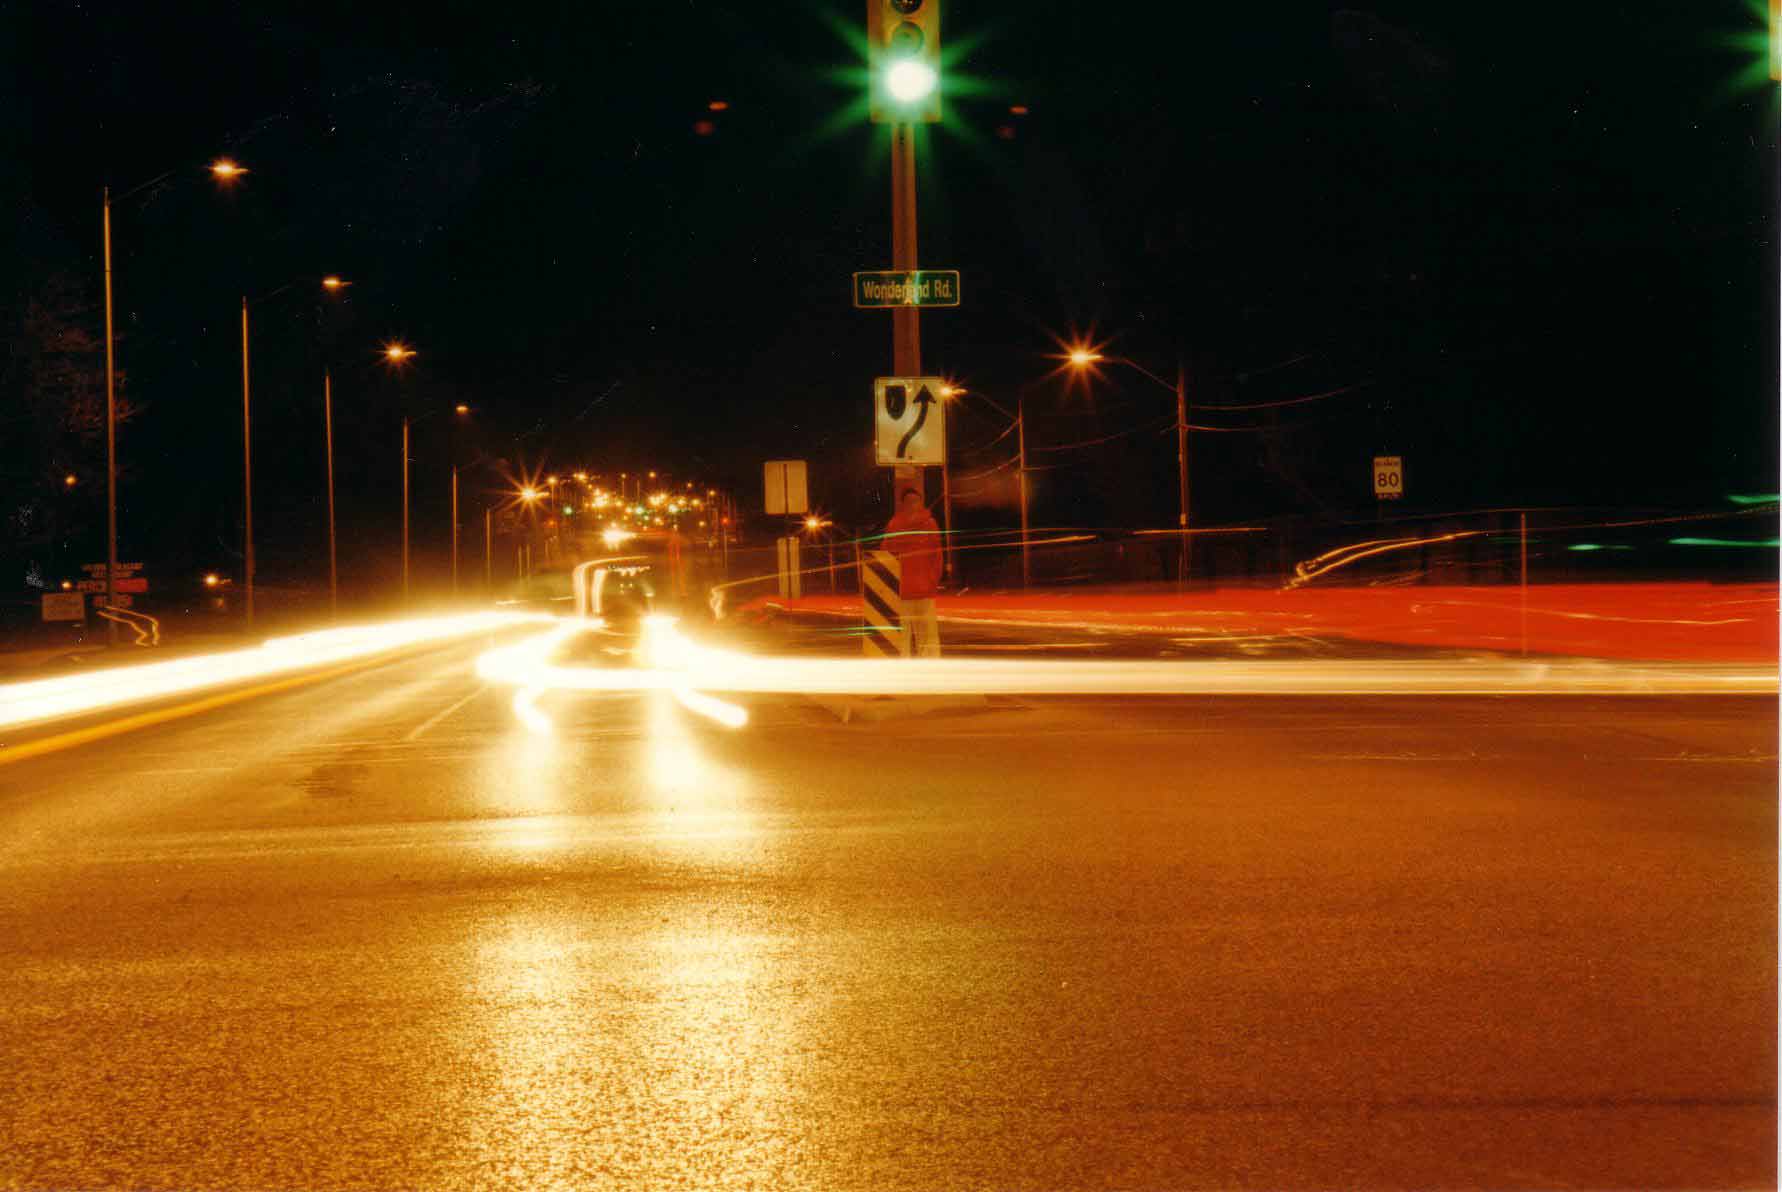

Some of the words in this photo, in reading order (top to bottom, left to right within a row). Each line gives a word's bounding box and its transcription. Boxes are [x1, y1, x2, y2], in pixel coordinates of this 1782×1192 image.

[863, 280, 930, 299] Wondernd
[935, 280, 953, 299] Rd.
[1377, 471, 1399, 488] 80
